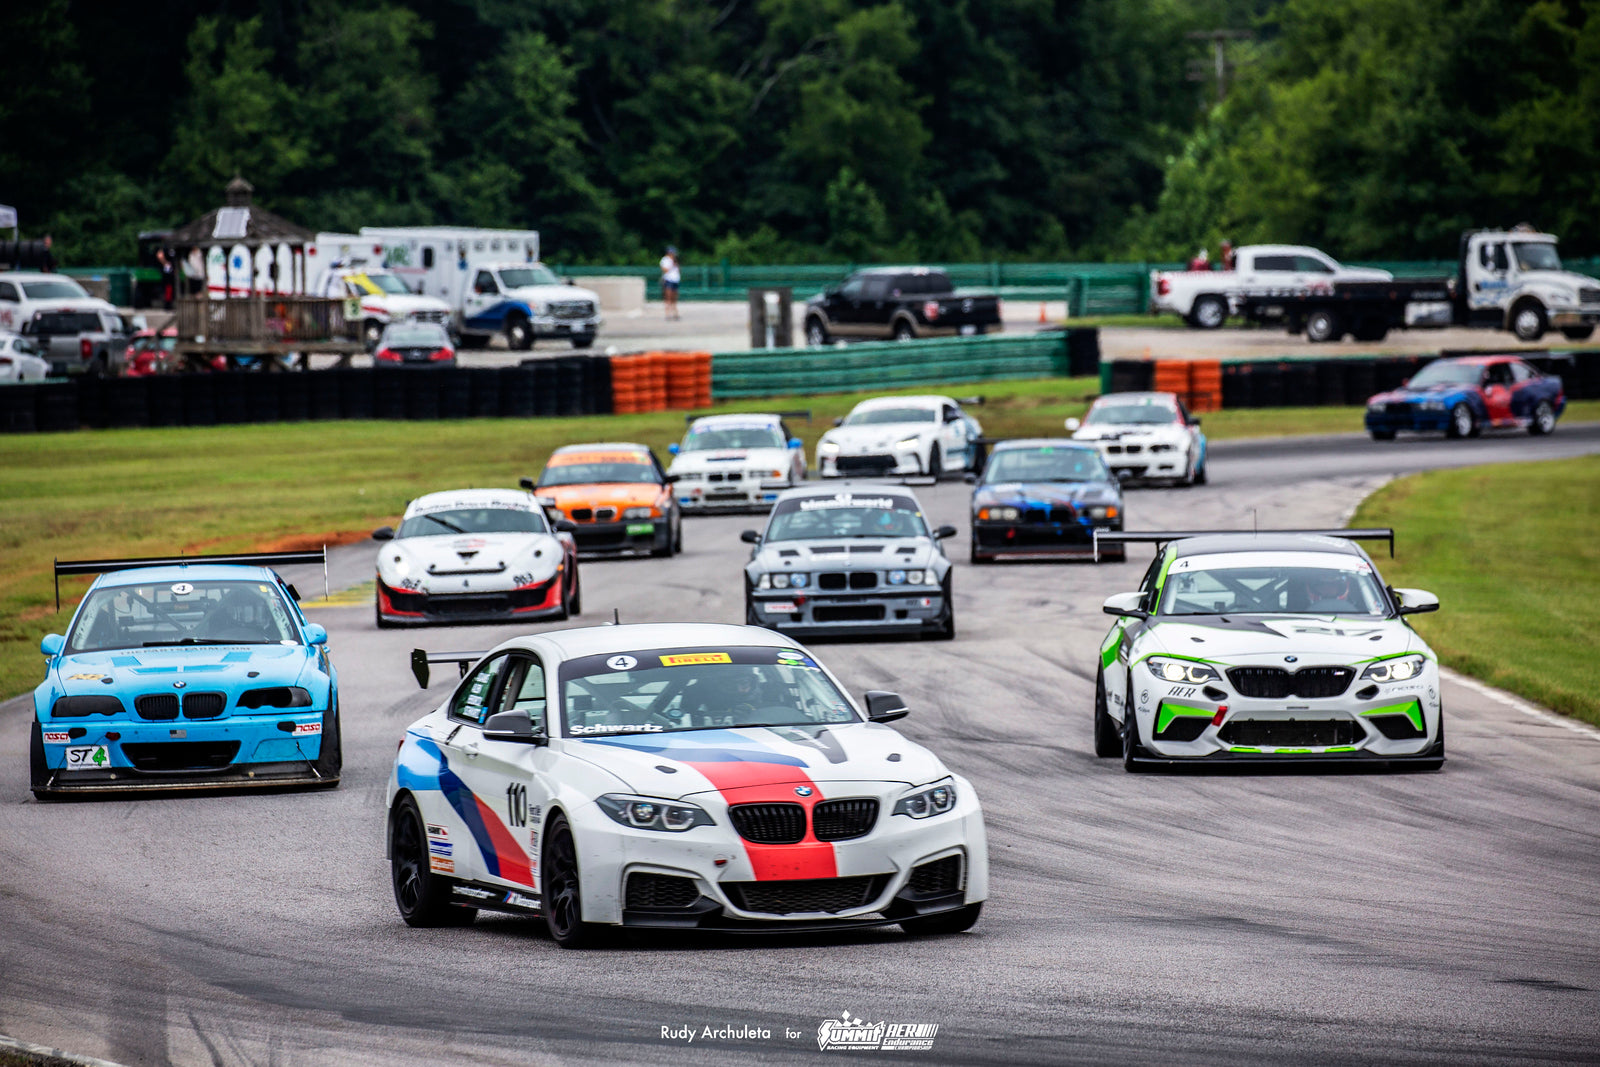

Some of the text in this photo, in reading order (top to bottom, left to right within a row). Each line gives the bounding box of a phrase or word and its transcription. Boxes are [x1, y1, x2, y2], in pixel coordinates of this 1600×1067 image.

[616, 657, 629, 668] 4
[669, 654, 725, 665] PIRELLI
[569, 724, 664, 736] Schwartz
[506, 782, 527, 828] 110
